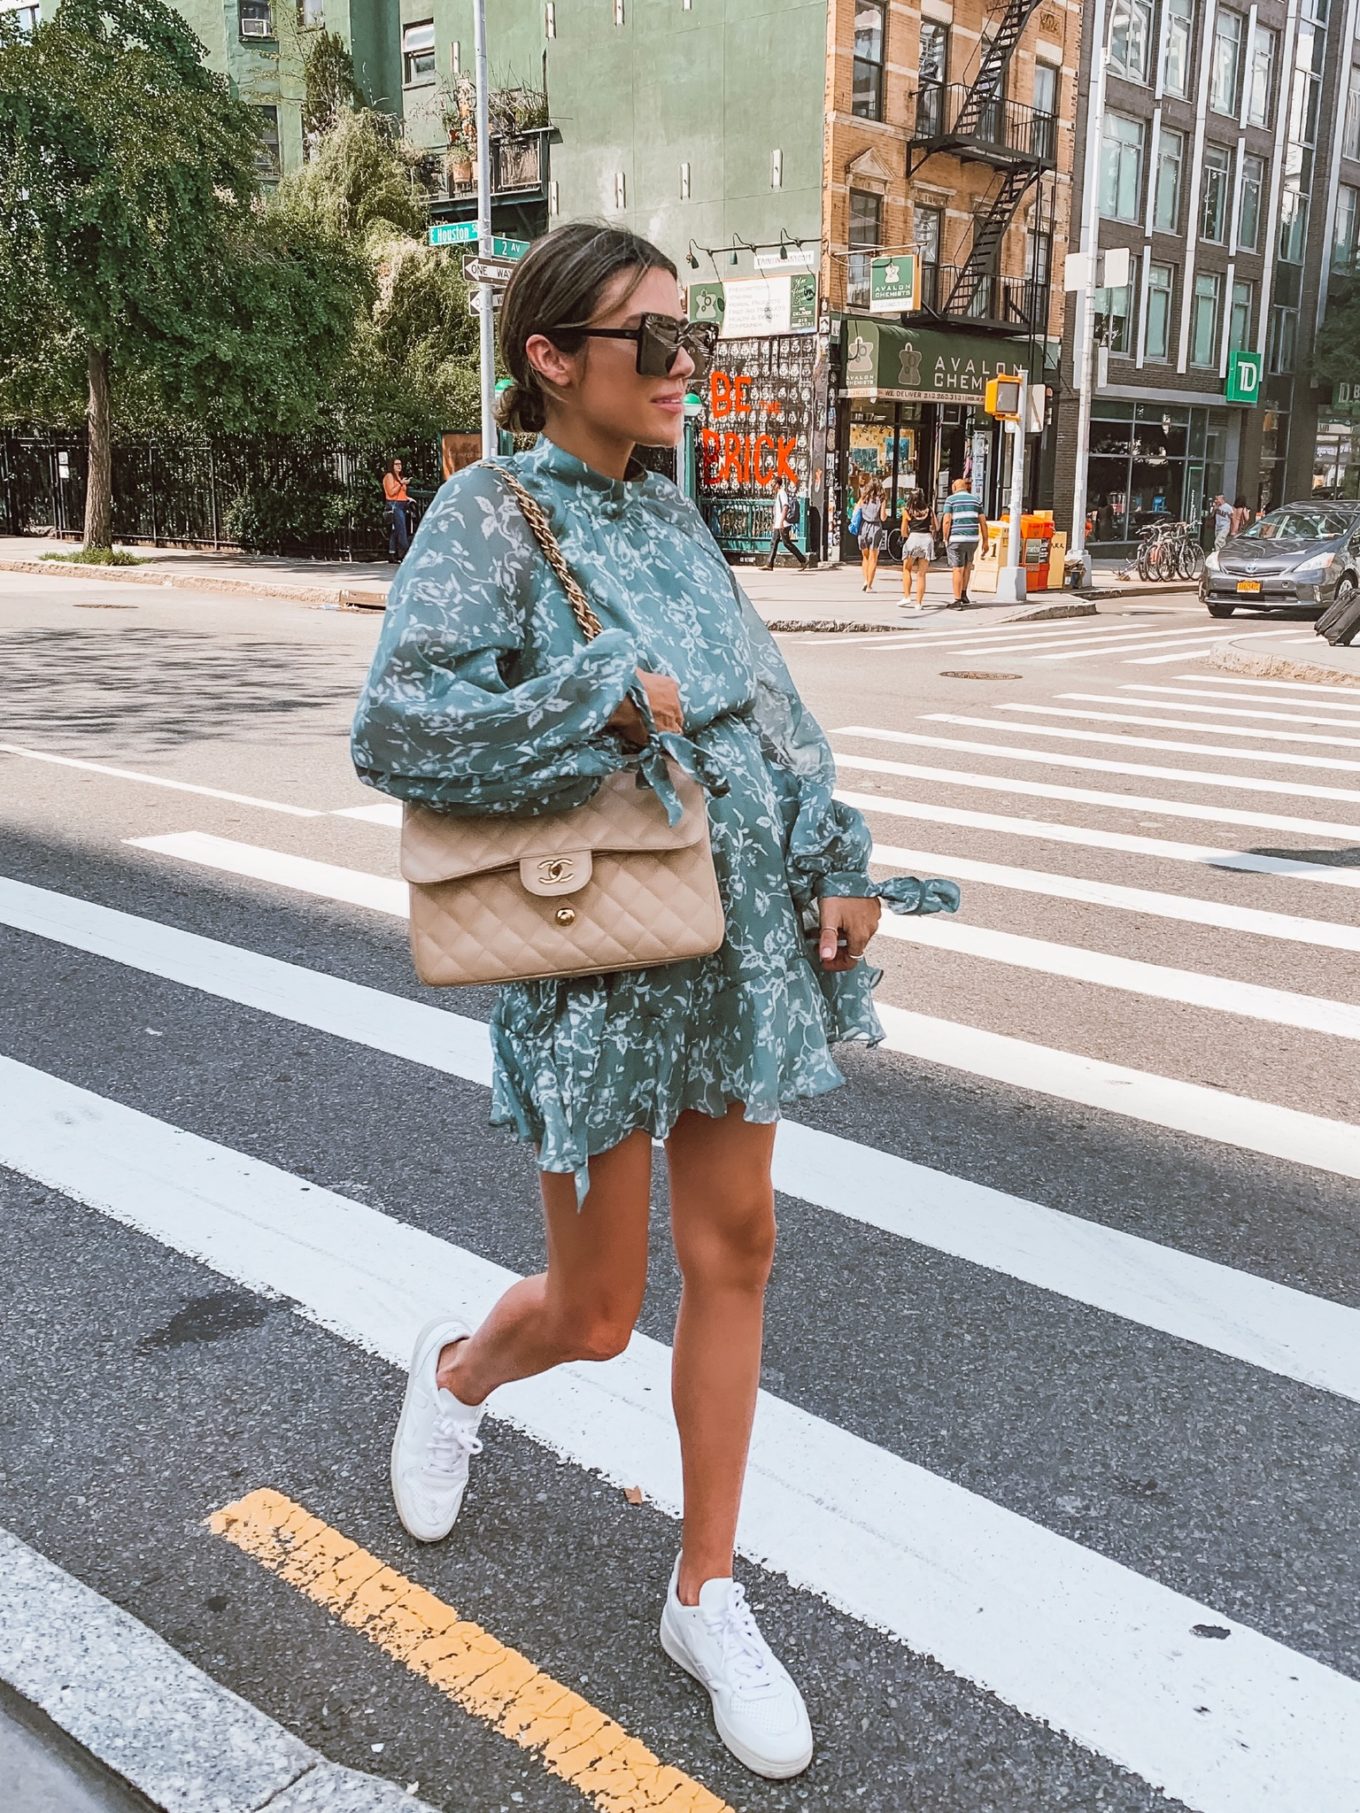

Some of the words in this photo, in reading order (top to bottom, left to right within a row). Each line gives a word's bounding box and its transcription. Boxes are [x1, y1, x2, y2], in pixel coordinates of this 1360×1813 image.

[430, 230, 435, 243] E
[437, 225, 469, 243] Houston
[502, 241, 507, 255] 2
[471, 264, 488, 276] ONE
[875, 284, 911, 292] AVALON
[875, 290, 911, 298] CHEMISTS
[935, 356, 1023, 375] AVALON
[934, 373, 989, 390] CHEM
[1237, 361, 1257, 392] TD
[711, 371, 752, 418] BE
[896, 390, 922, 398] DELIVER
